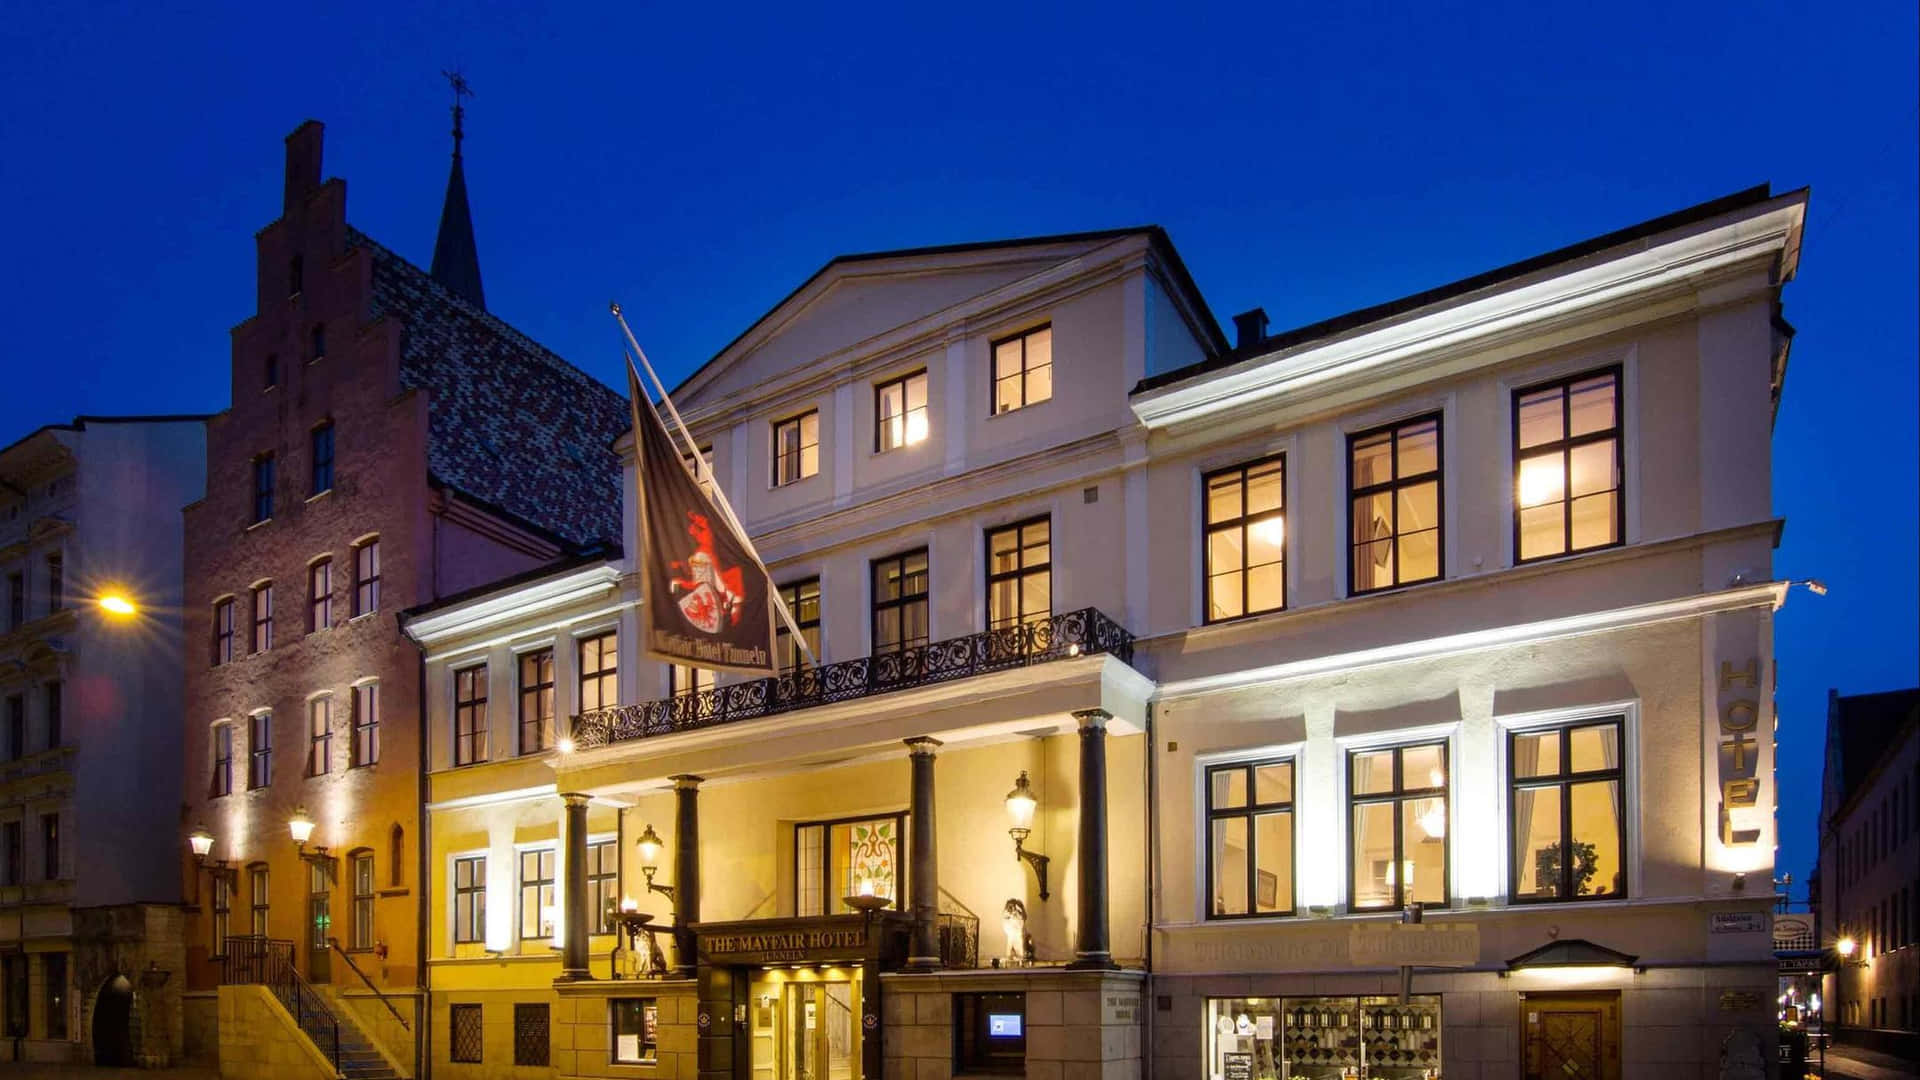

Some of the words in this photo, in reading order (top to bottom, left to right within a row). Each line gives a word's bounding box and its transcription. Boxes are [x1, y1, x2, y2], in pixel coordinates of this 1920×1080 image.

[1720, 658, 1758, 848] HOTEL
[705, 935, 735, 953] THE
[740, 932, 806, 952] MAYFAIR
[811, 929, 865, 949] HOTEL
